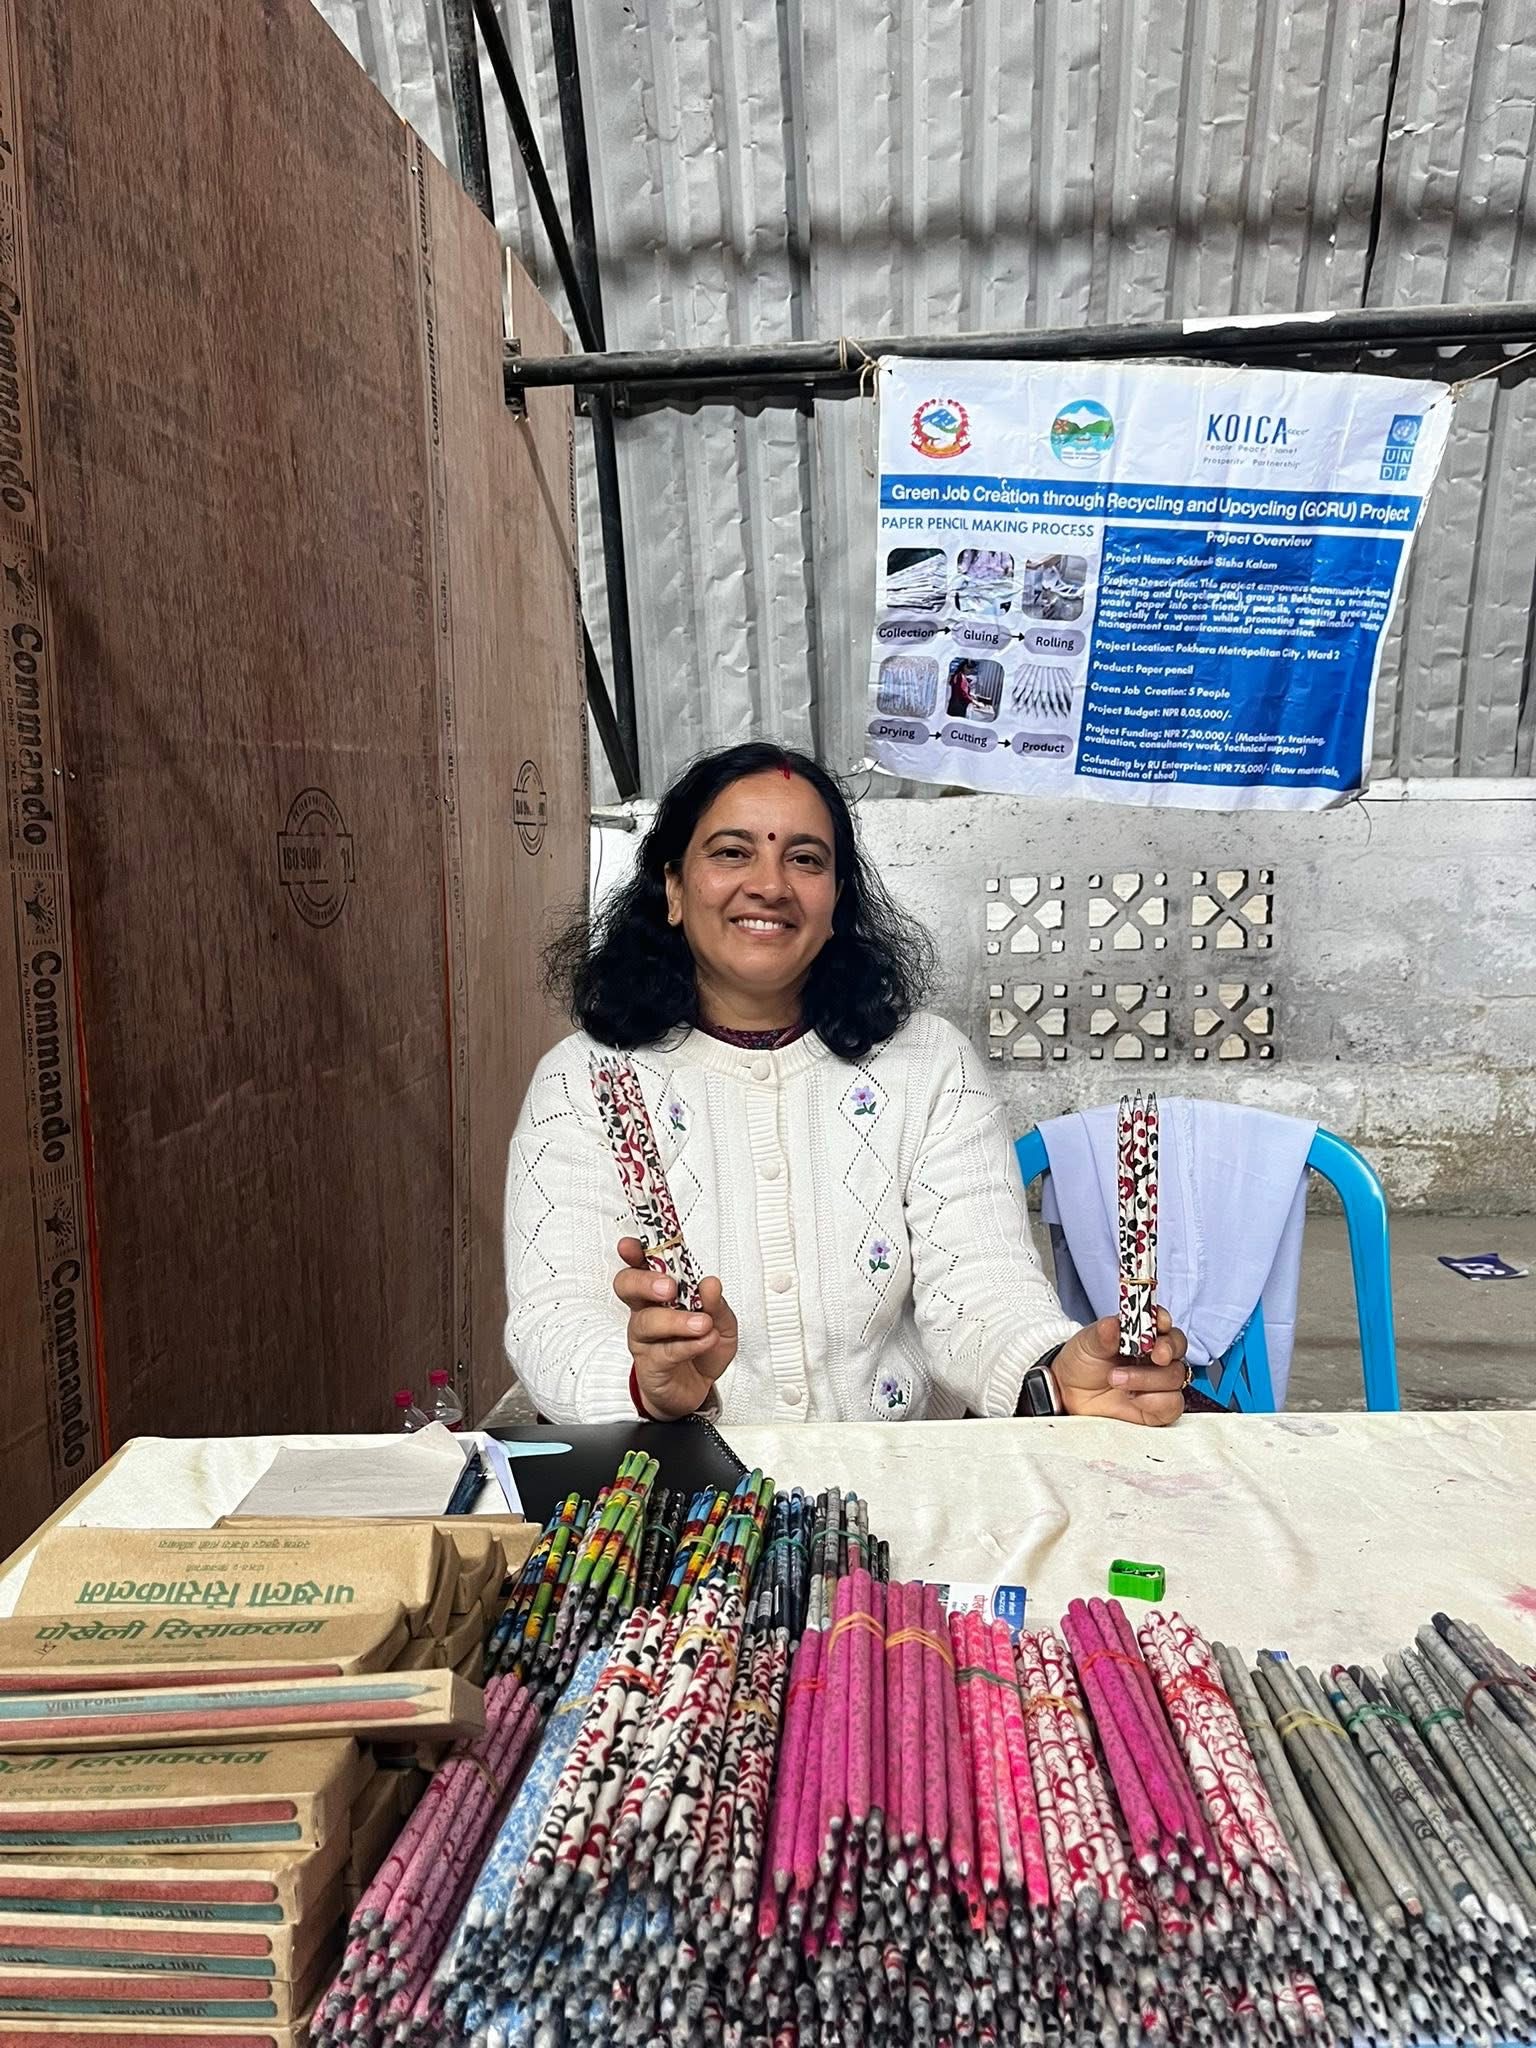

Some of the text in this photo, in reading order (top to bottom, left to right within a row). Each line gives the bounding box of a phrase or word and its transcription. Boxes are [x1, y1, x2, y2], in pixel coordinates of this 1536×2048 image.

[426, 318, 441, 447] Commando
[1205, 413, 1288, 446] KOICA
[891, 484, 1411, 524] Green Job Creation through Recycling and Upcycling (GCRU) Project
[881, 516, 1096, 538] PAPER PENCIL MAKING PROCESS
[1205, 530, 1313, 548] Project Overview
[1105, 552, 1142, 567] Project
[1143, 554, 1176, 566] Name:
[1214, 557, 1244, 569] Sisha
[1245, 559, 1278, 570] Kalam
[1103, 575, 1139, 589] Project
[1219, 581, 1256, 592] project
[1257, 583, 1309, 595] empowers
[1101, 587, 1150, 601] Recycling
[1152, 590, 1172, 600] and
[1245, 594, 1274, 606] group
[1278, 594, 1288, 604] in
[1335, 597, 1346, 608] to
[1099, 610, 1150, 622] especially
[1154, 610, 1169, 621] for
[1174, 612, 1208, 622] women
[1212, 612, 1240, 623] while
[1244, 615, 1296, 629] promoting
[1100, 599, 1131, 608] waste
[1135, 602, 1165, 612] paper
[1168, 600, 1189, 610] into
[1192, 602, 1250, 615] eco-friendly
[1294, 606, 1337, 619] creating
[1340, 609, 1367, 622] green
[878, 627, 1075, 651] Collection Gluing Rolling
[1097, 619, 1317, 638] management and environmental conservation.
[1095, 639, 1130, 653] Project
[1132, 641, 1175, 653] Location:
[1175, 643, 1217, 655] Pokhara
[1217, 645, 1281, 659] Metropolitan
[1306, 650, 1334, 660] Ward
[1333, 650, 1341, 660] 2
[1093, 661, 1195, 677] Product: Paper pencil
[1090, 681, 1231, 701] Green Job Creation: 5 People
[1088, 702, 1233, 722] Project Budget: NPR 8,05,000/-
[11, 622, 53, 846] Commando
[879, 725, 1065, 754] Drying Cutting Product
[1085, 723, 1120, 737] Project
[1120, 728, 1163, 741] Funding:
[1163, 729, 1181, 739] NPR
[1181, 729, 1234, 743] 7,30,000/-
[1234, 732, 1287, 745] (Machinery,
[1084, 735, 1308, 757] evaluation, consultancy work, technical support)
[1080, 765, 1178, 783] construction of shed)
[1081, 753, 1341, 779] Cofunding by RU Enterprise: NPR 75,000/- (Raw materials,
[31, 950, 71, 1164] Commando
[52, 1259, 90, 1469] Commando
[150, 1618, 329, 1641] सिसाकलम
